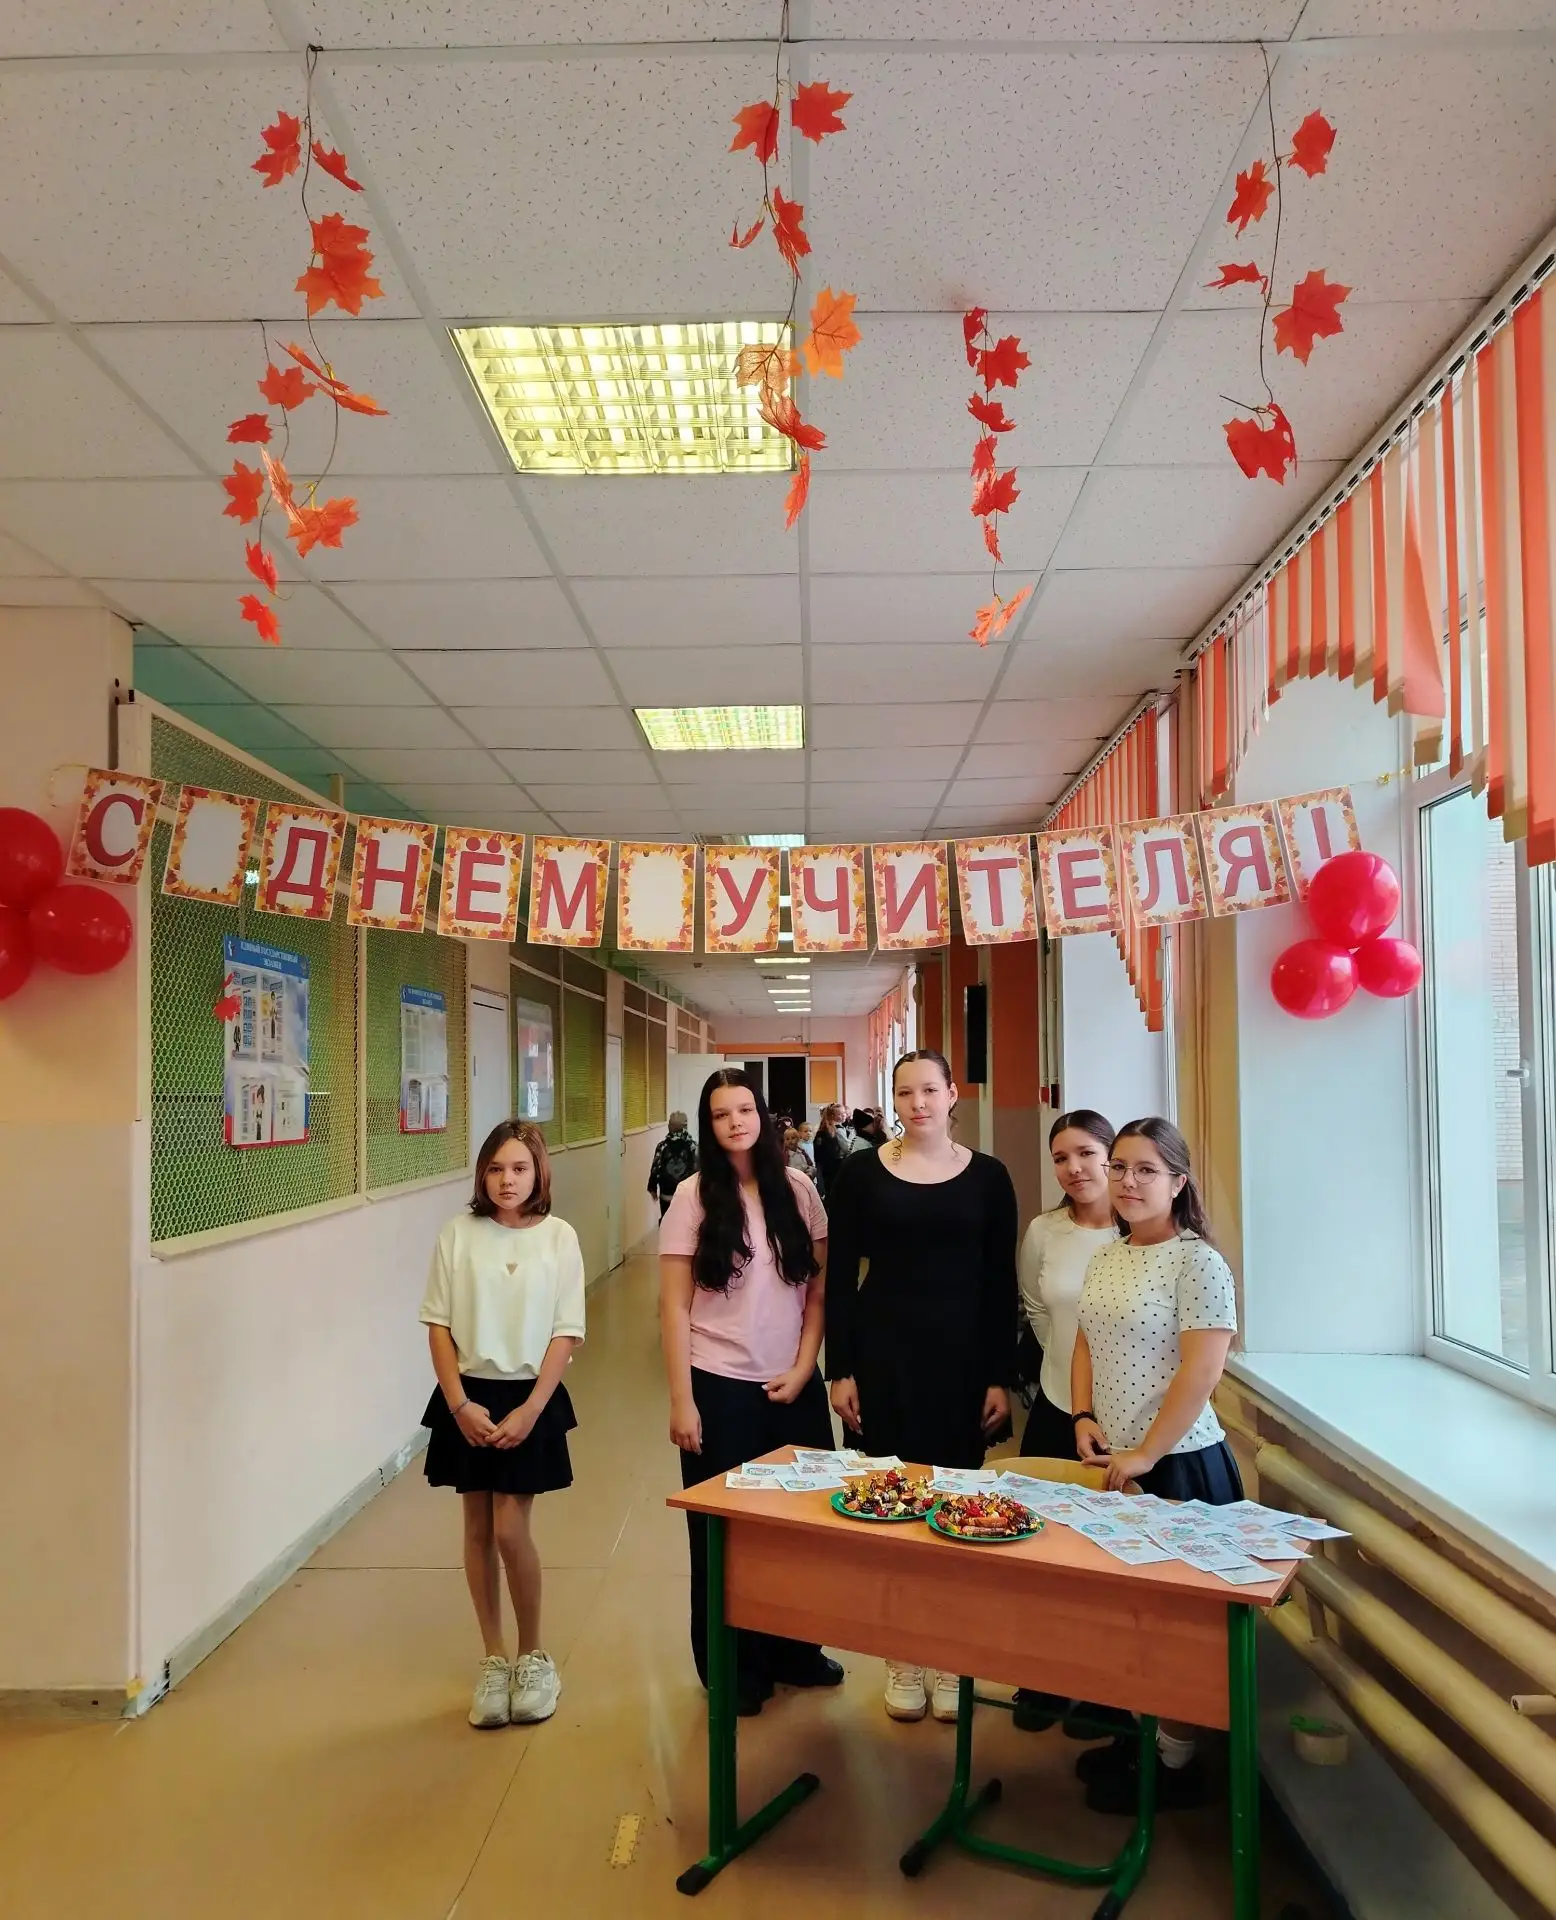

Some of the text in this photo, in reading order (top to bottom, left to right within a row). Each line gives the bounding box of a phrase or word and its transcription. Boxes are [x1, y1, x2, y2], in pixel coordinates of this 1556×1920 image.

[85, 793, 1332, 937] С ДНЁМ УЧИТЕЛЯ!
